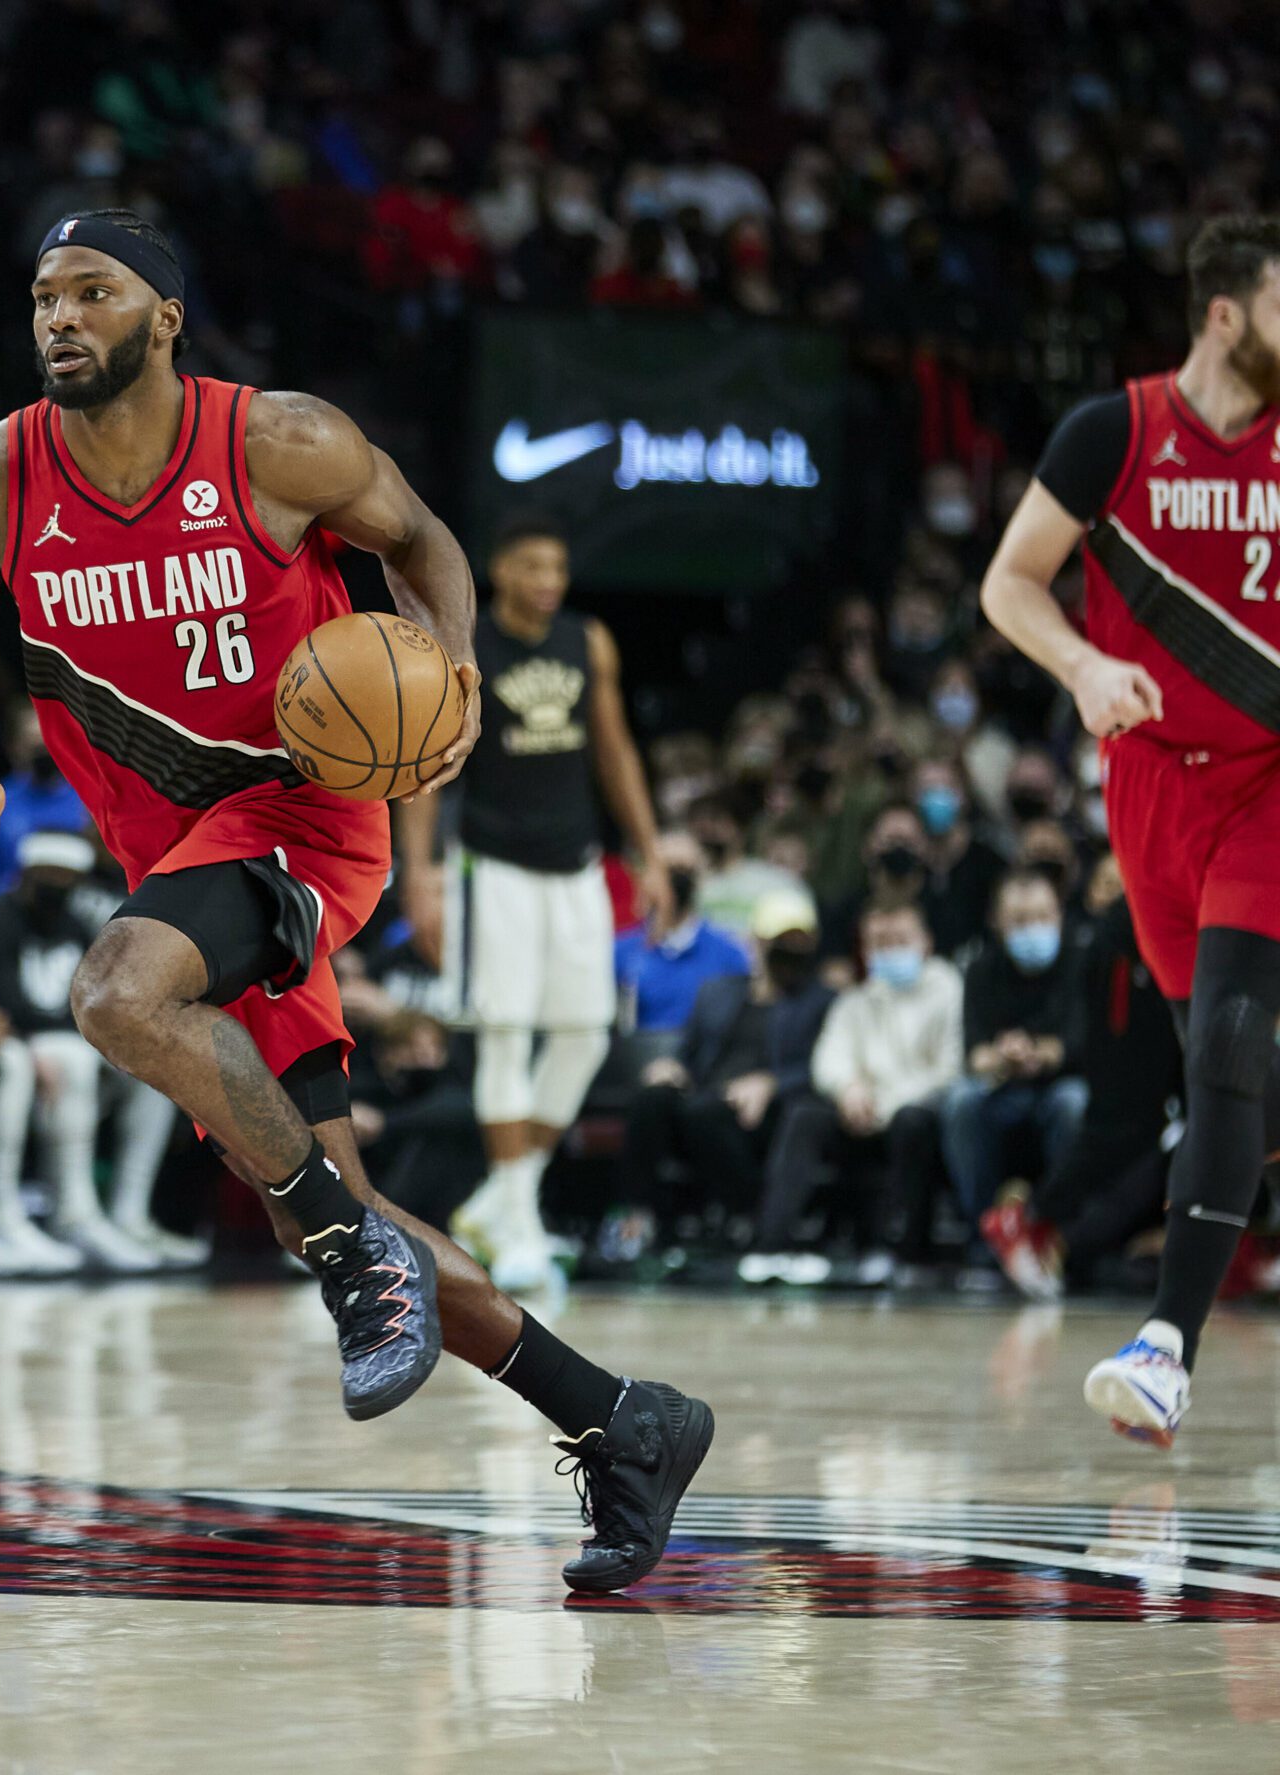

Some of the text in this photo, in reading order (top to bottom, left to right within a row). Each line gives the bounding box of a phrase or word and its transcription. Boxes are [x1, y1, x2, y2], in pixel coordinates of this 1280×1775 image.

[180, 515, 228, 532] StormX
[30, 547, 248, 628] PORTLAND
[1240, 535, 1280, 602] 2
[174, 611, 256, 692] 26
